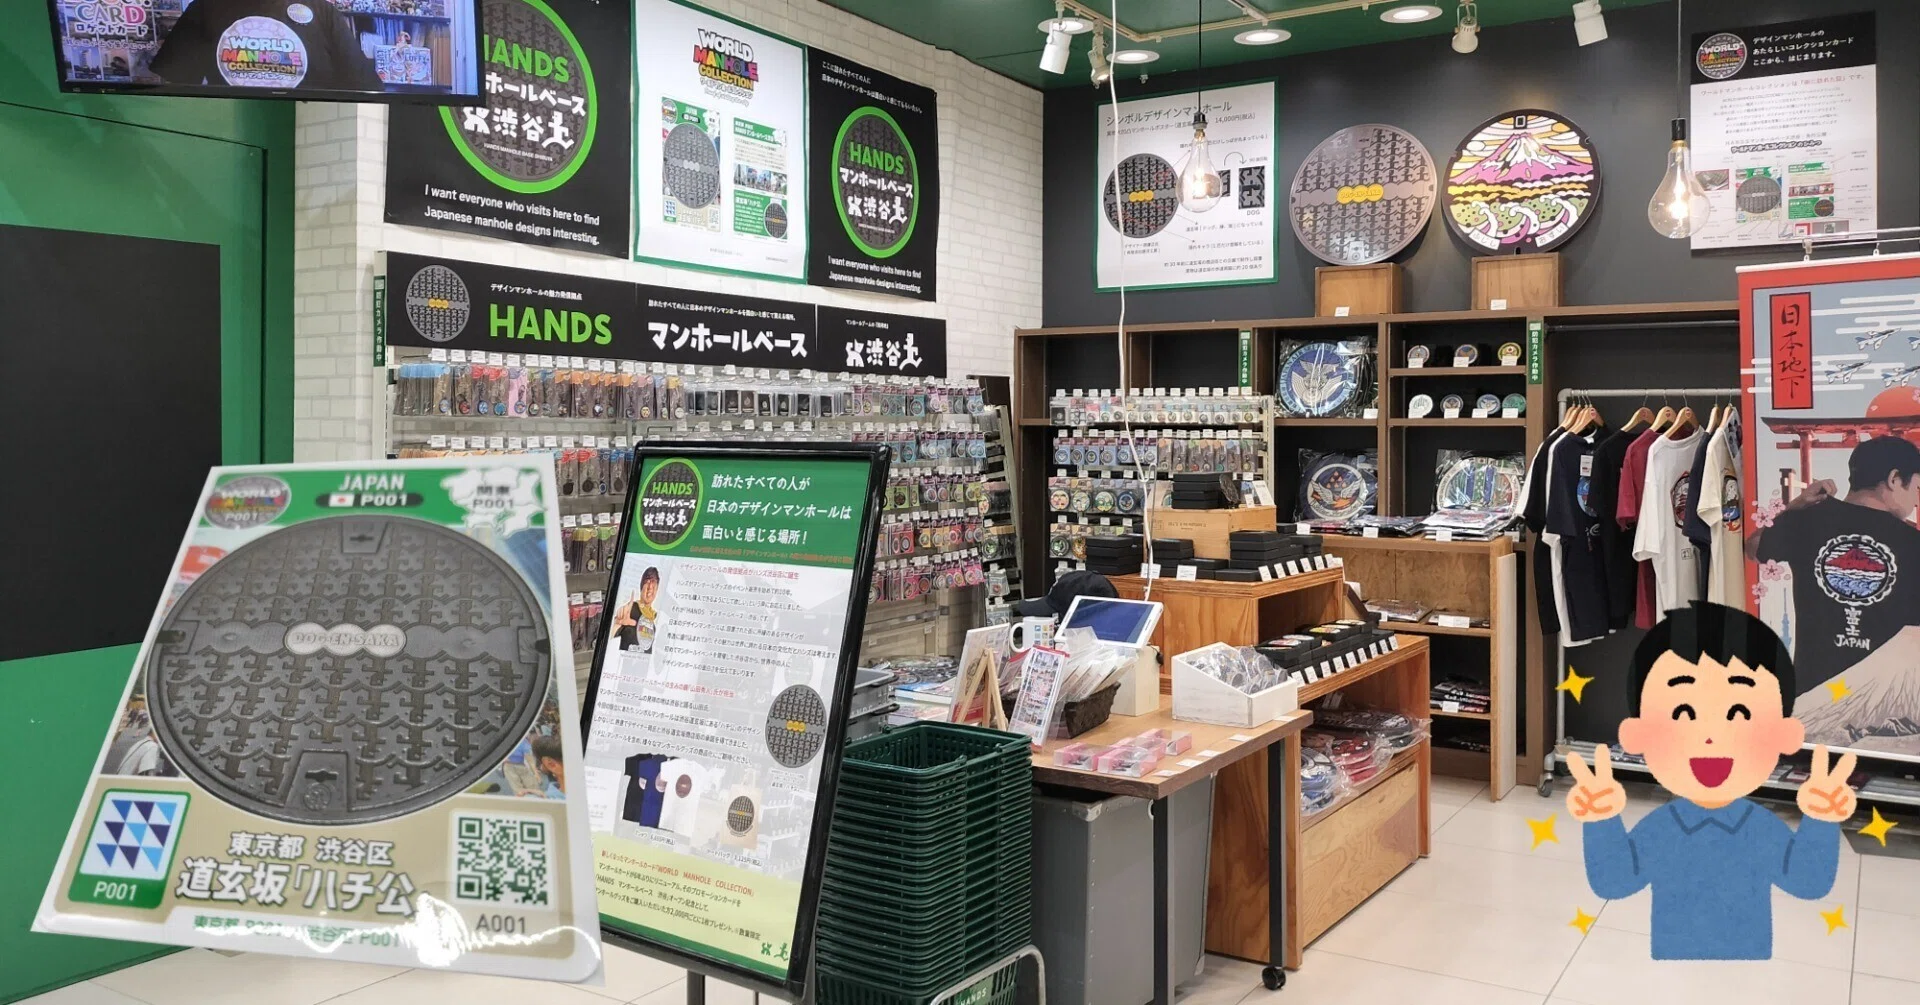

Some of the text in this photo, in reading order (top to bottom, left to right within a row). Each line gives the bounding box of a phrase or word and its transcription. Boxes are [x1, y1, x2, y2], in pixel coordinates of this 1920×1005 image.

[75, 4, 147, 25] CARD
[75, 24, 148, 36] ロケットカード
[1753, 30, 1825, 44] デザインマンホールの
[228, 36, 295, 51] WORLD
[697, 28, 754, 61] WORLD
[1753, 37, 1854, 56] あたらしいコレクションカード
[221, 49, 303, 66] MANHOLE
[693, 45, 759, 82] MANHOLE
[226, 62, 297, 74] COLLECTION
[698, 63, 754, 91] COLLECTION
[485, 72, 587, 117] ホールベース
[850, 142, 905, 174] HANDS
[840, 167, 914, 198] マンホールベース
[431, 188, 457, 200] want
[459, 193, 502, 209] everyone
[505, 200, 524, 212] who
[526, 203, 551, 217] visits
[553, 207, 572, 221] here
[573, 212, 583, 222] to
[584, 213, 600, 226] find
[424, 206, 600, 245] Japanese manhole designs interesting.
[831, 258, 845, 268] want
[845, 260, 869, 272] everyone
[870, 263, 880, 273] who
[829, 271, 853, 284] Japanese
[876, 278, 895, 290] designs
[489, 303, 613, 345] HANDS
[648, 322, 808, 358] マンホールベース
[1531, 330, 1539, 382] 防犯カメラ作動中
[339, 473, 406, 491] JAPAN
[476, 485, 510, 496] 関東
[652, 481, 694, 496] HANDS
[711, 473, 811, 491] 訪れたすべての人が
[361, 494, 408, 507] P001
[472, 497, 515, 509] P001
[642, 497, 697, 509] マンホールベース
[706, 500, 852, 520] 日本のデザインマンホールは
[1844, 607, 1862, 636] 富士
[1834, 634, 1871, 651] JAPAN
[227, 830, 395, 867] 東京都 渋谷区
[174, 857, 416, 918] 道玄坂「ハチ公
[683, 871, 711, 885] MANHOLE
[93, 881, 138, 901] P001
[475, 914, 527, 935] A001
